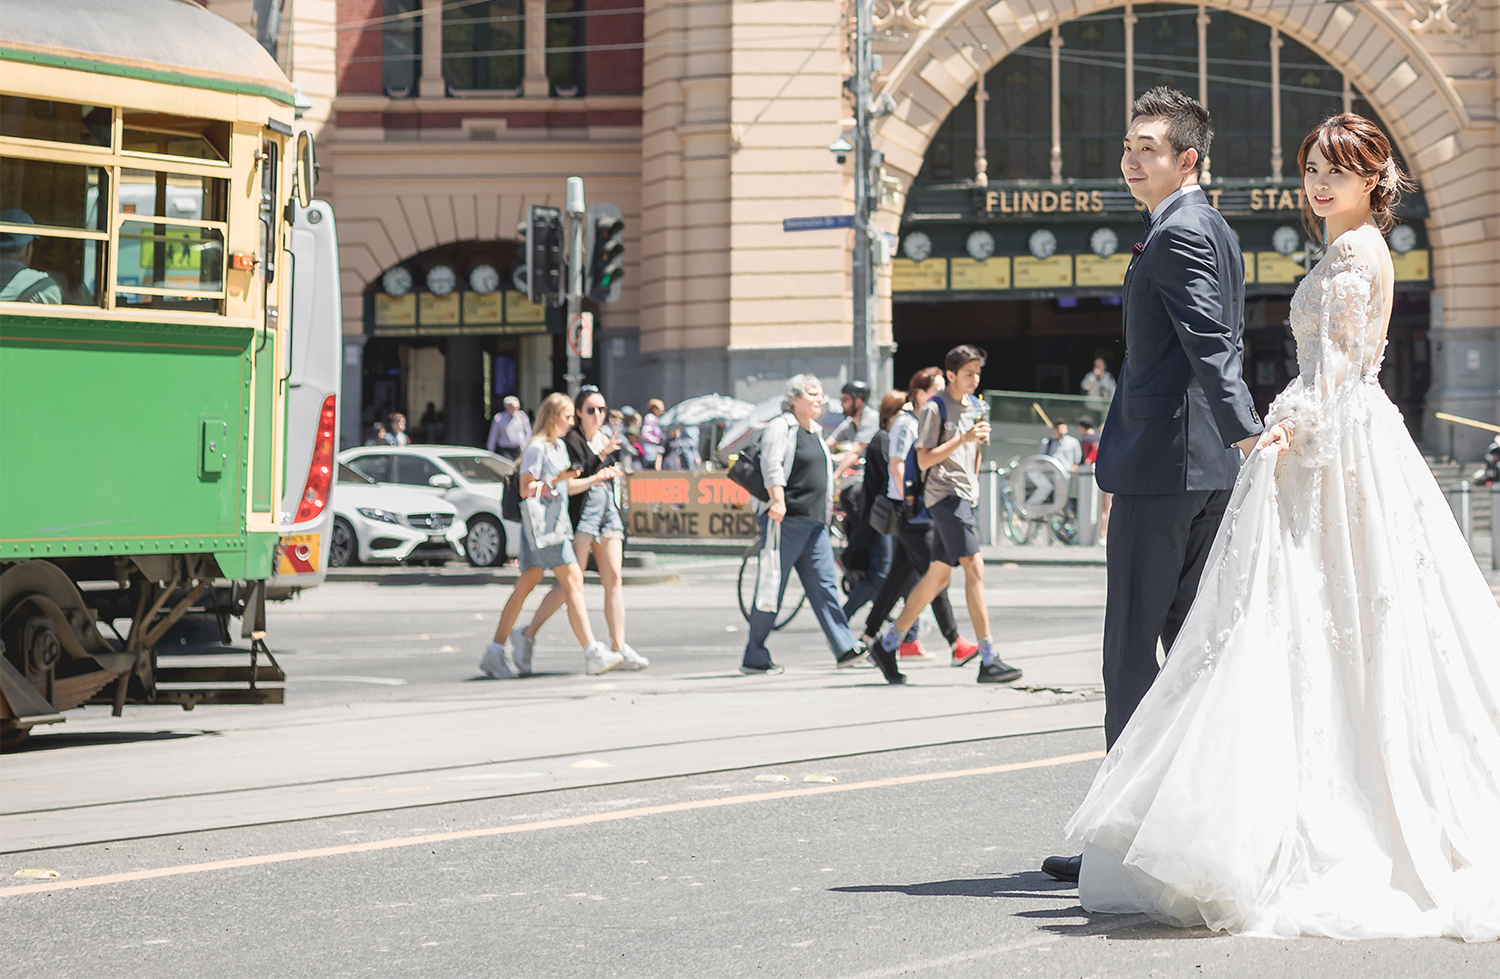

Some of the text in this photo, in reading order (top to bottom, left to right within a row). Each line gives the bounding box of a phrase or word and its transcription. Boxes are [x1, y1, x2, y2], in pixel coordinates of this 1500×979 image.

[986, 189, 1104, 213] FLINDERS
[1250, 188, 1306, 211] STAT
[629, 477, 690, 504] HUNGER
[633, 511, 699, 535] CLIMATE
